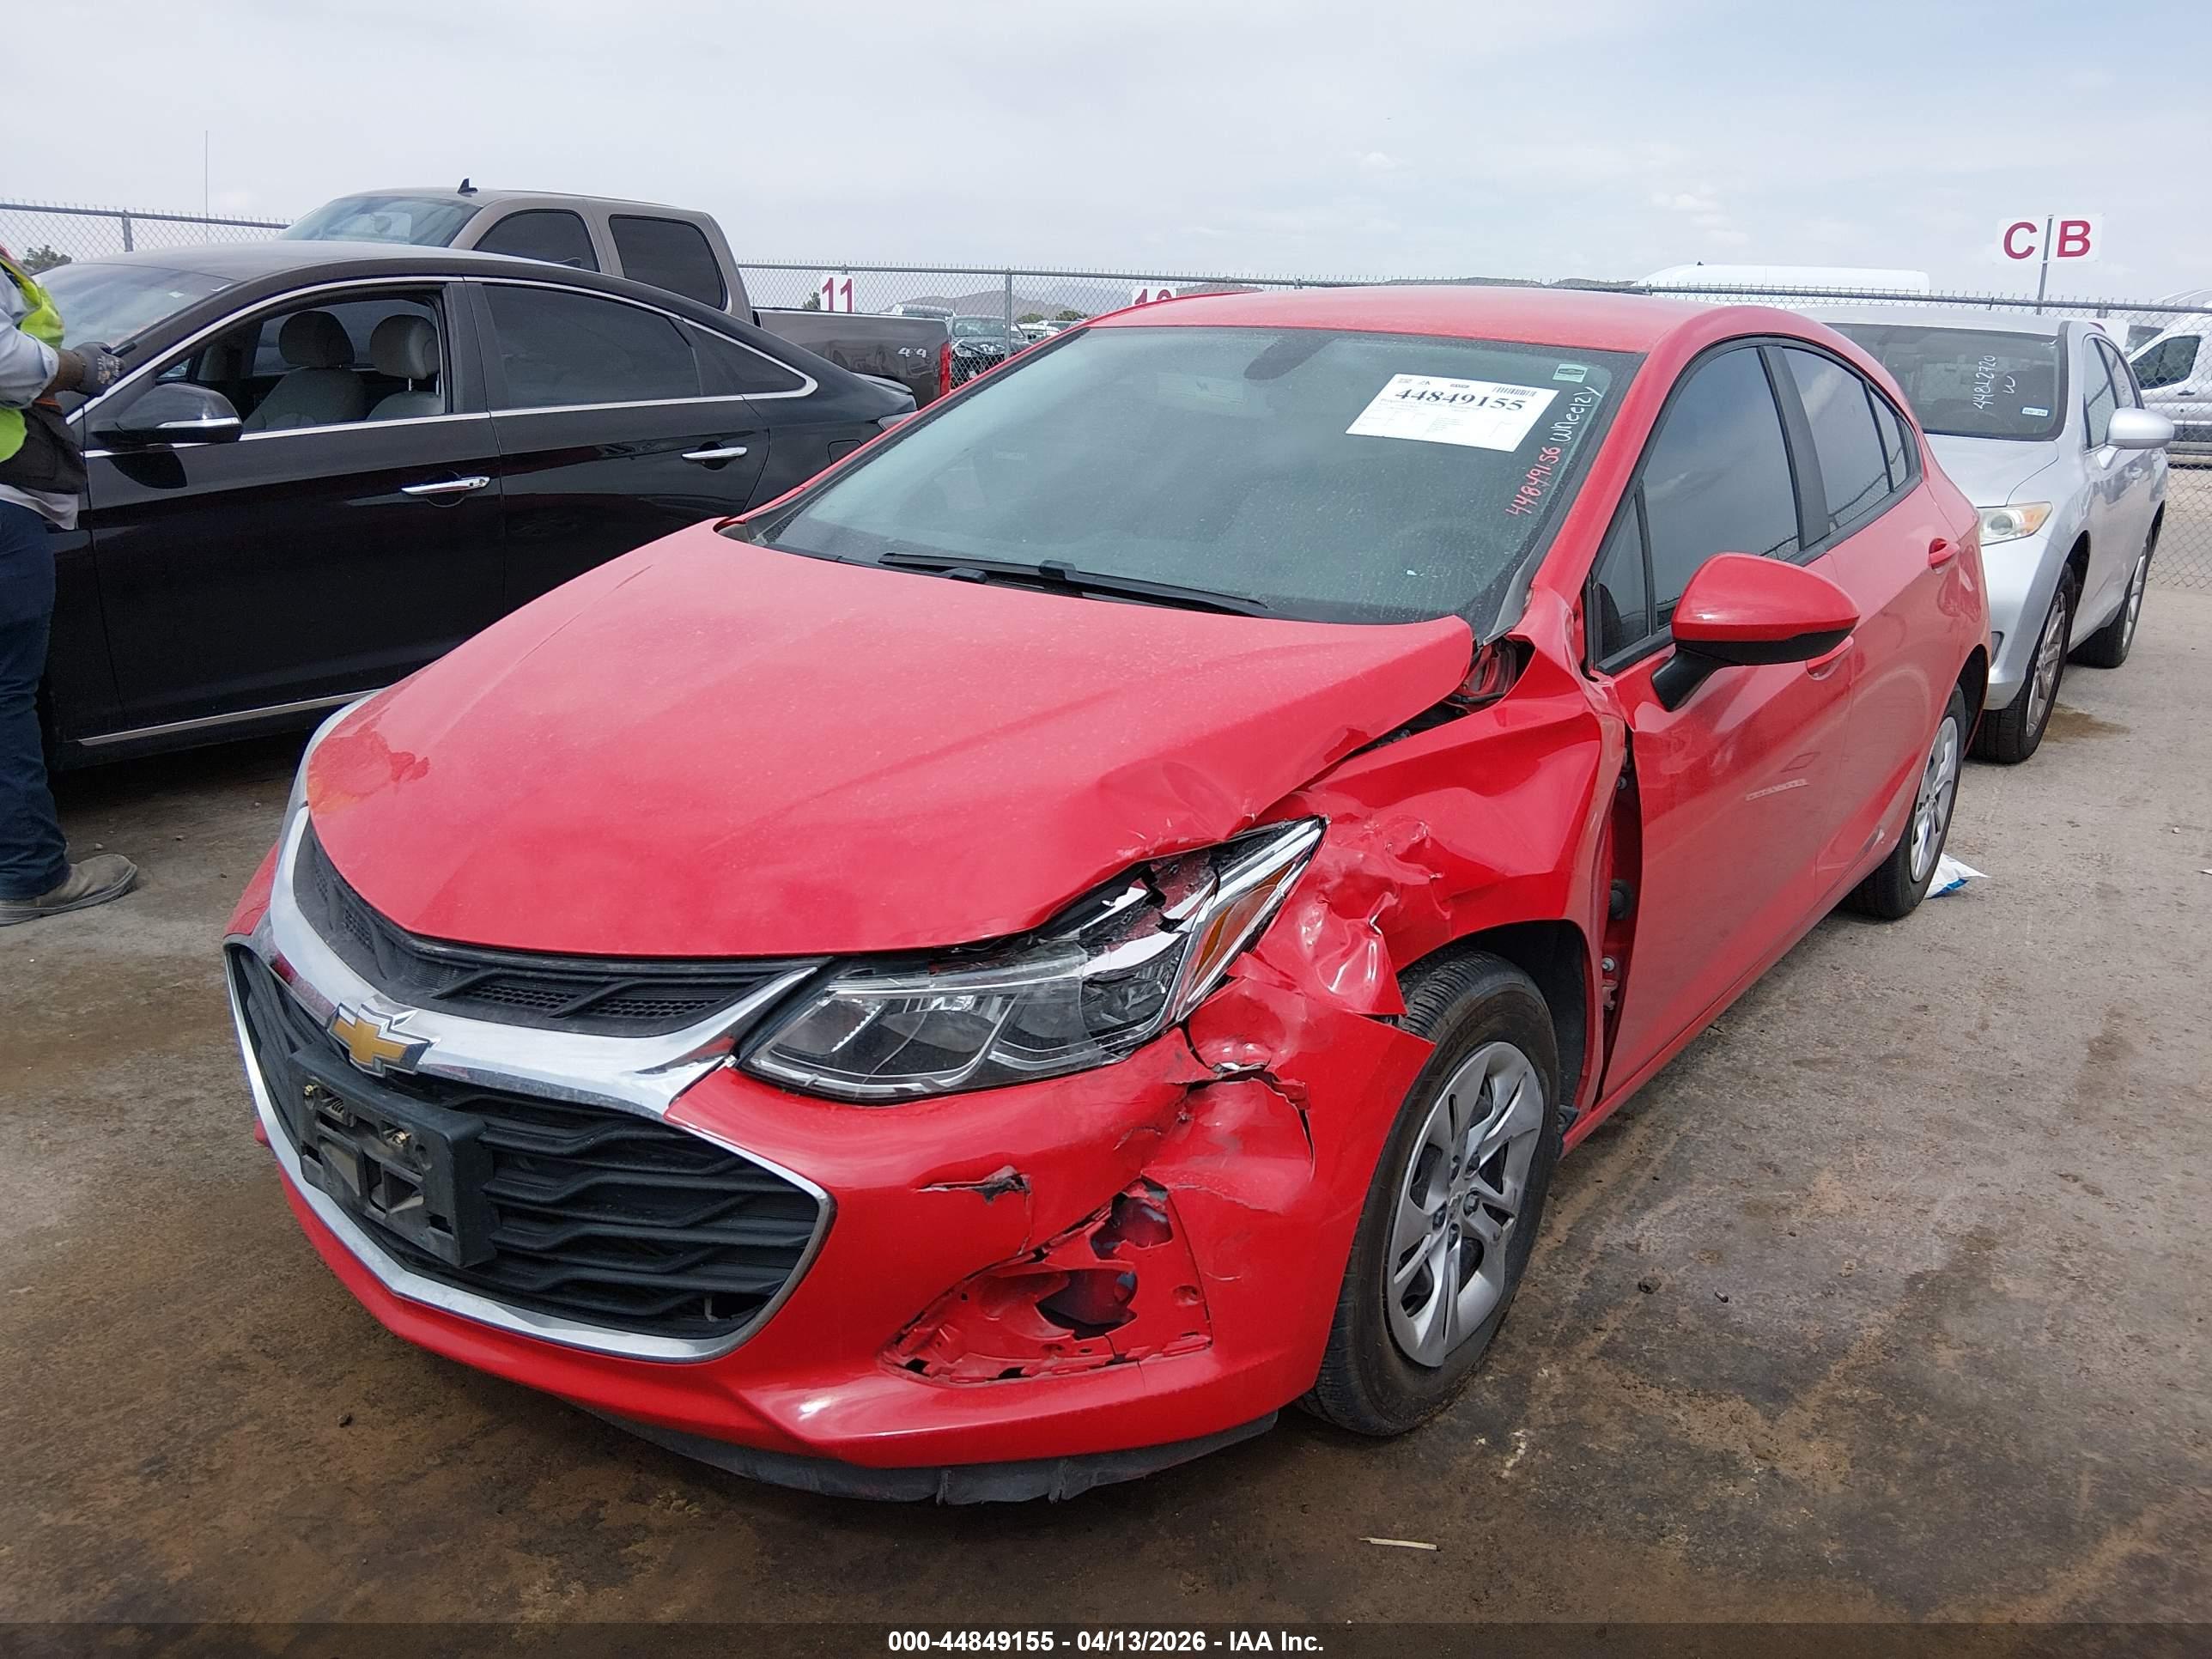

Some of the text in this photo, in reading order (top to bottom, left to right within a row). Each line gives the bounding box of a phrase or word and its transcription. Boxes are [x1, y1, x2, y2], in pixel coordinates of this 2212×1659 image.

[2003, 222, 2038, 259] C
[2057, 220, 2091, 258] B
[821, 277, 853, 313] 11
[1395, 388, 1528, 412] 44849155
